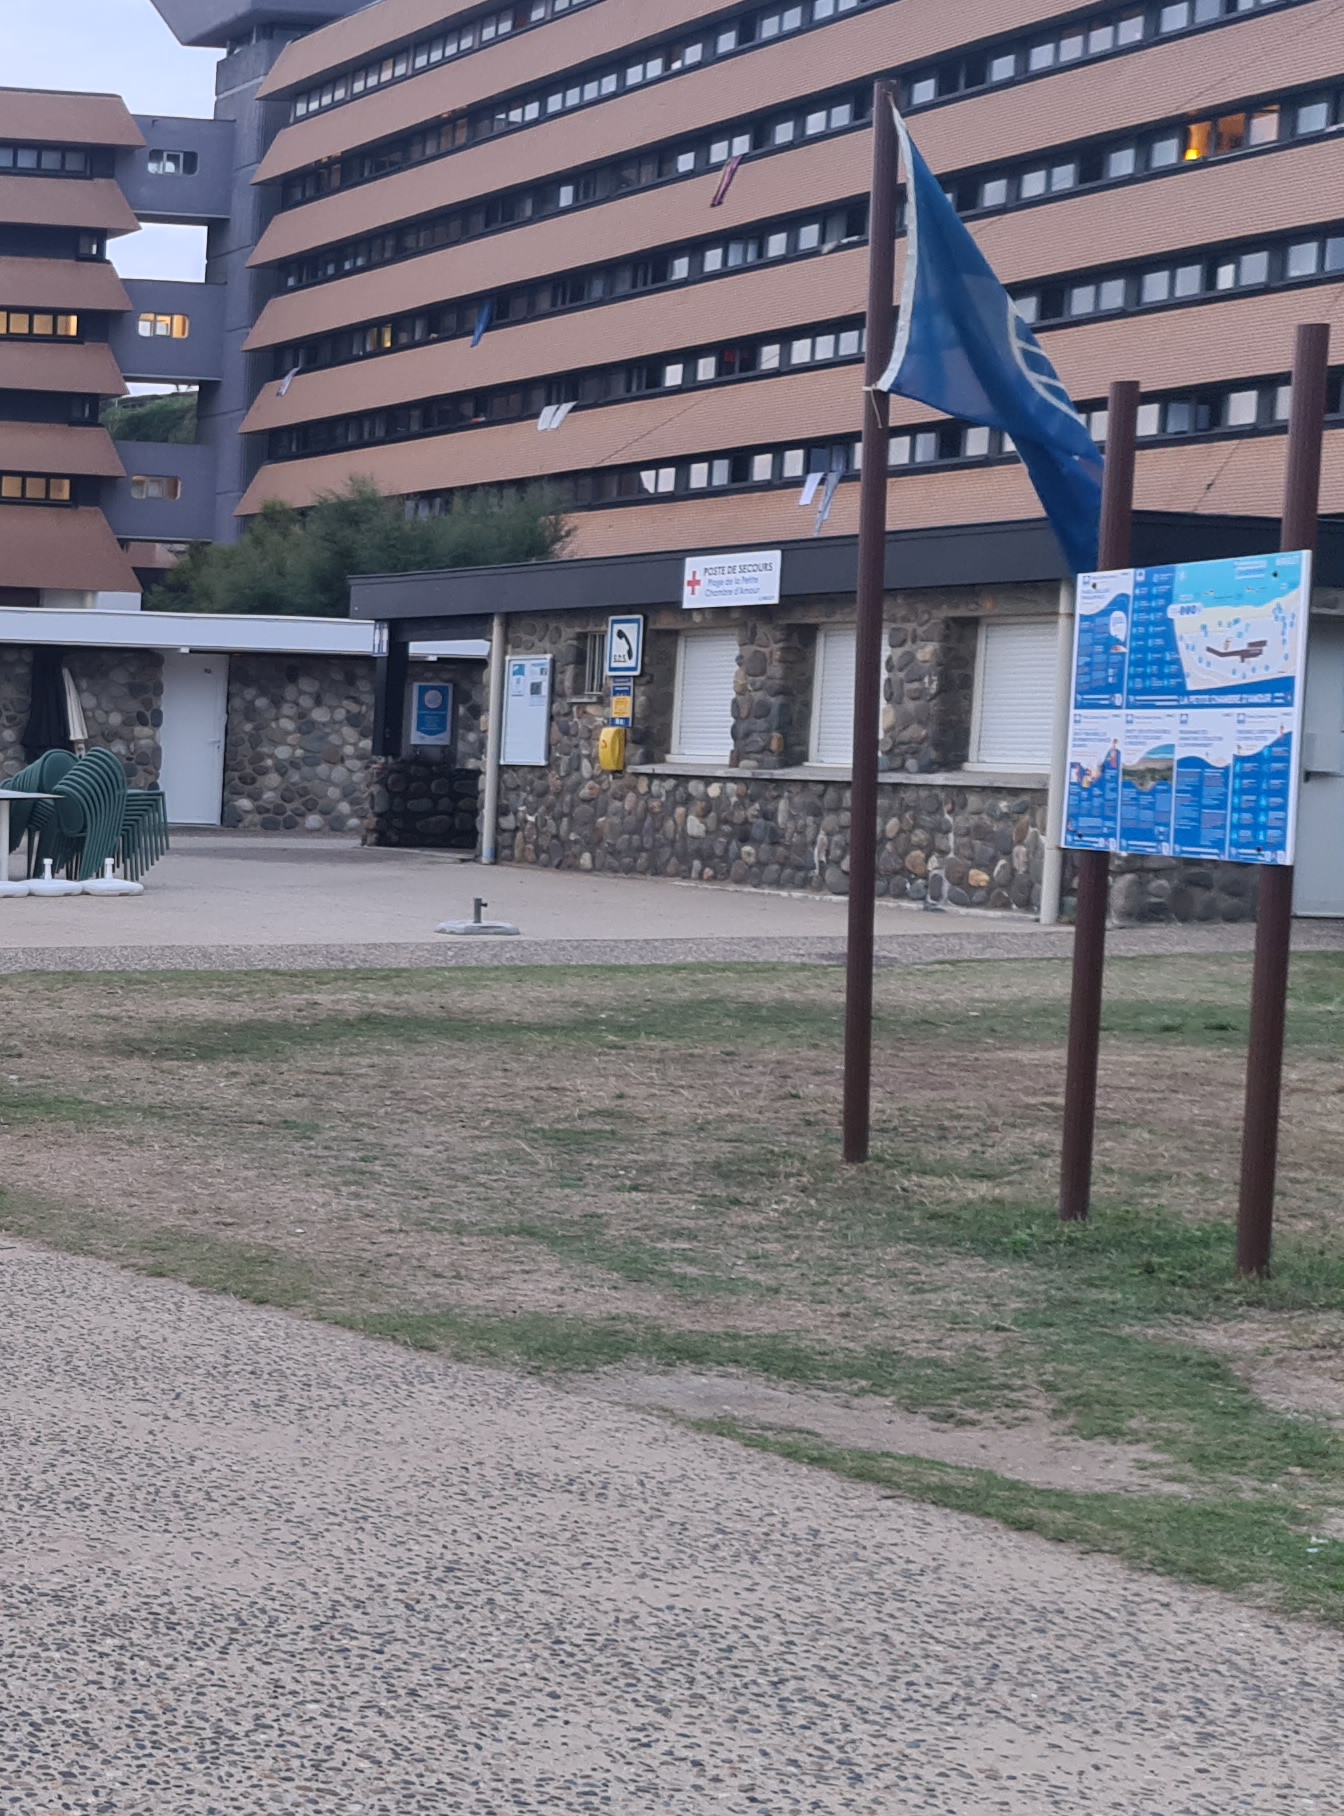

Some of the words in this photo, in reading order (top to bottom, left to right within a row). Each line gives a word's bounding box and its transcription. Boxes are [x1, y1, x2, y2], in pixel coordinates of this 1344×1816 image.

[704, 565, 726, 576] POSTE
[727, 565, 737, 574] DE
[738, 562, 773, 573] SECOURS
[708, 579, 724, 588] Plage
[705, 588, 733, 597] Chambre
